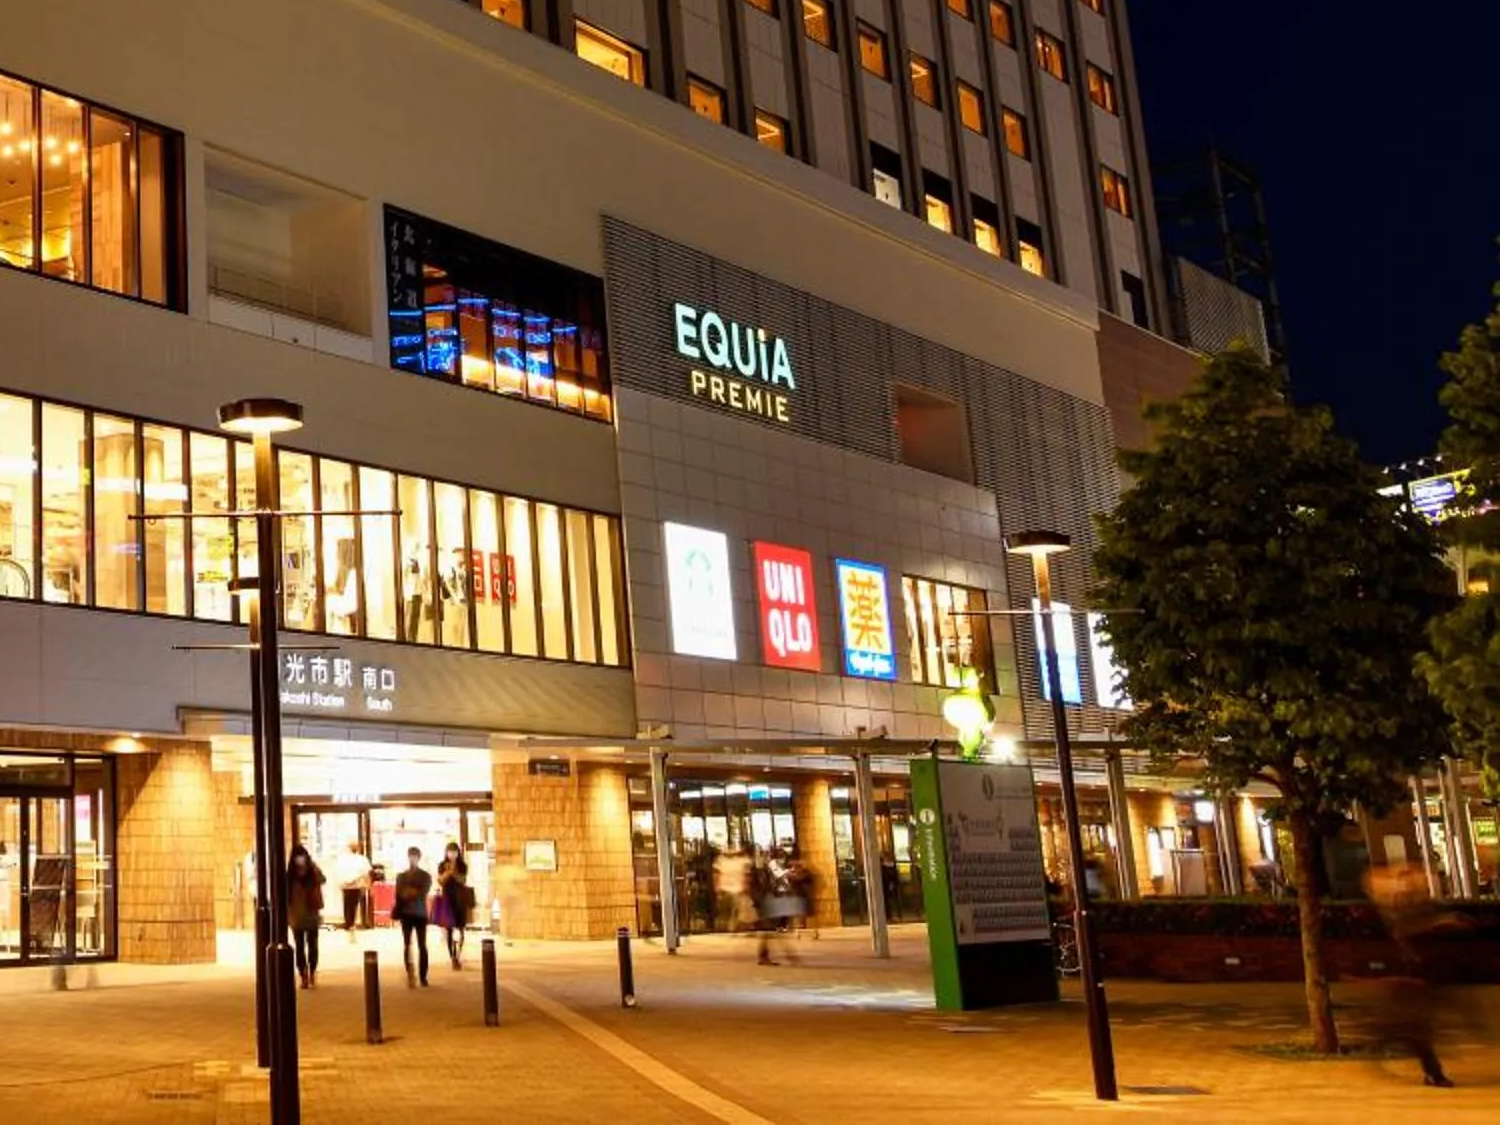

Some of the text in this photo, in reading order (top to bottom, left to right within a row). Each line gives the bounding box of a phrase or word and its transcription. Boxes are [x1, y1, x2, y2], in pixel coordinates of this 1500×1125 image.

[691, 370, 789, 422] PREMIE
[763, 559, 805, 606] UNI
[769, 608, 812, 657] QLO
[847, 571, 884, 648] 薬
[285, 653, 395, 691] 光市駅 南口
